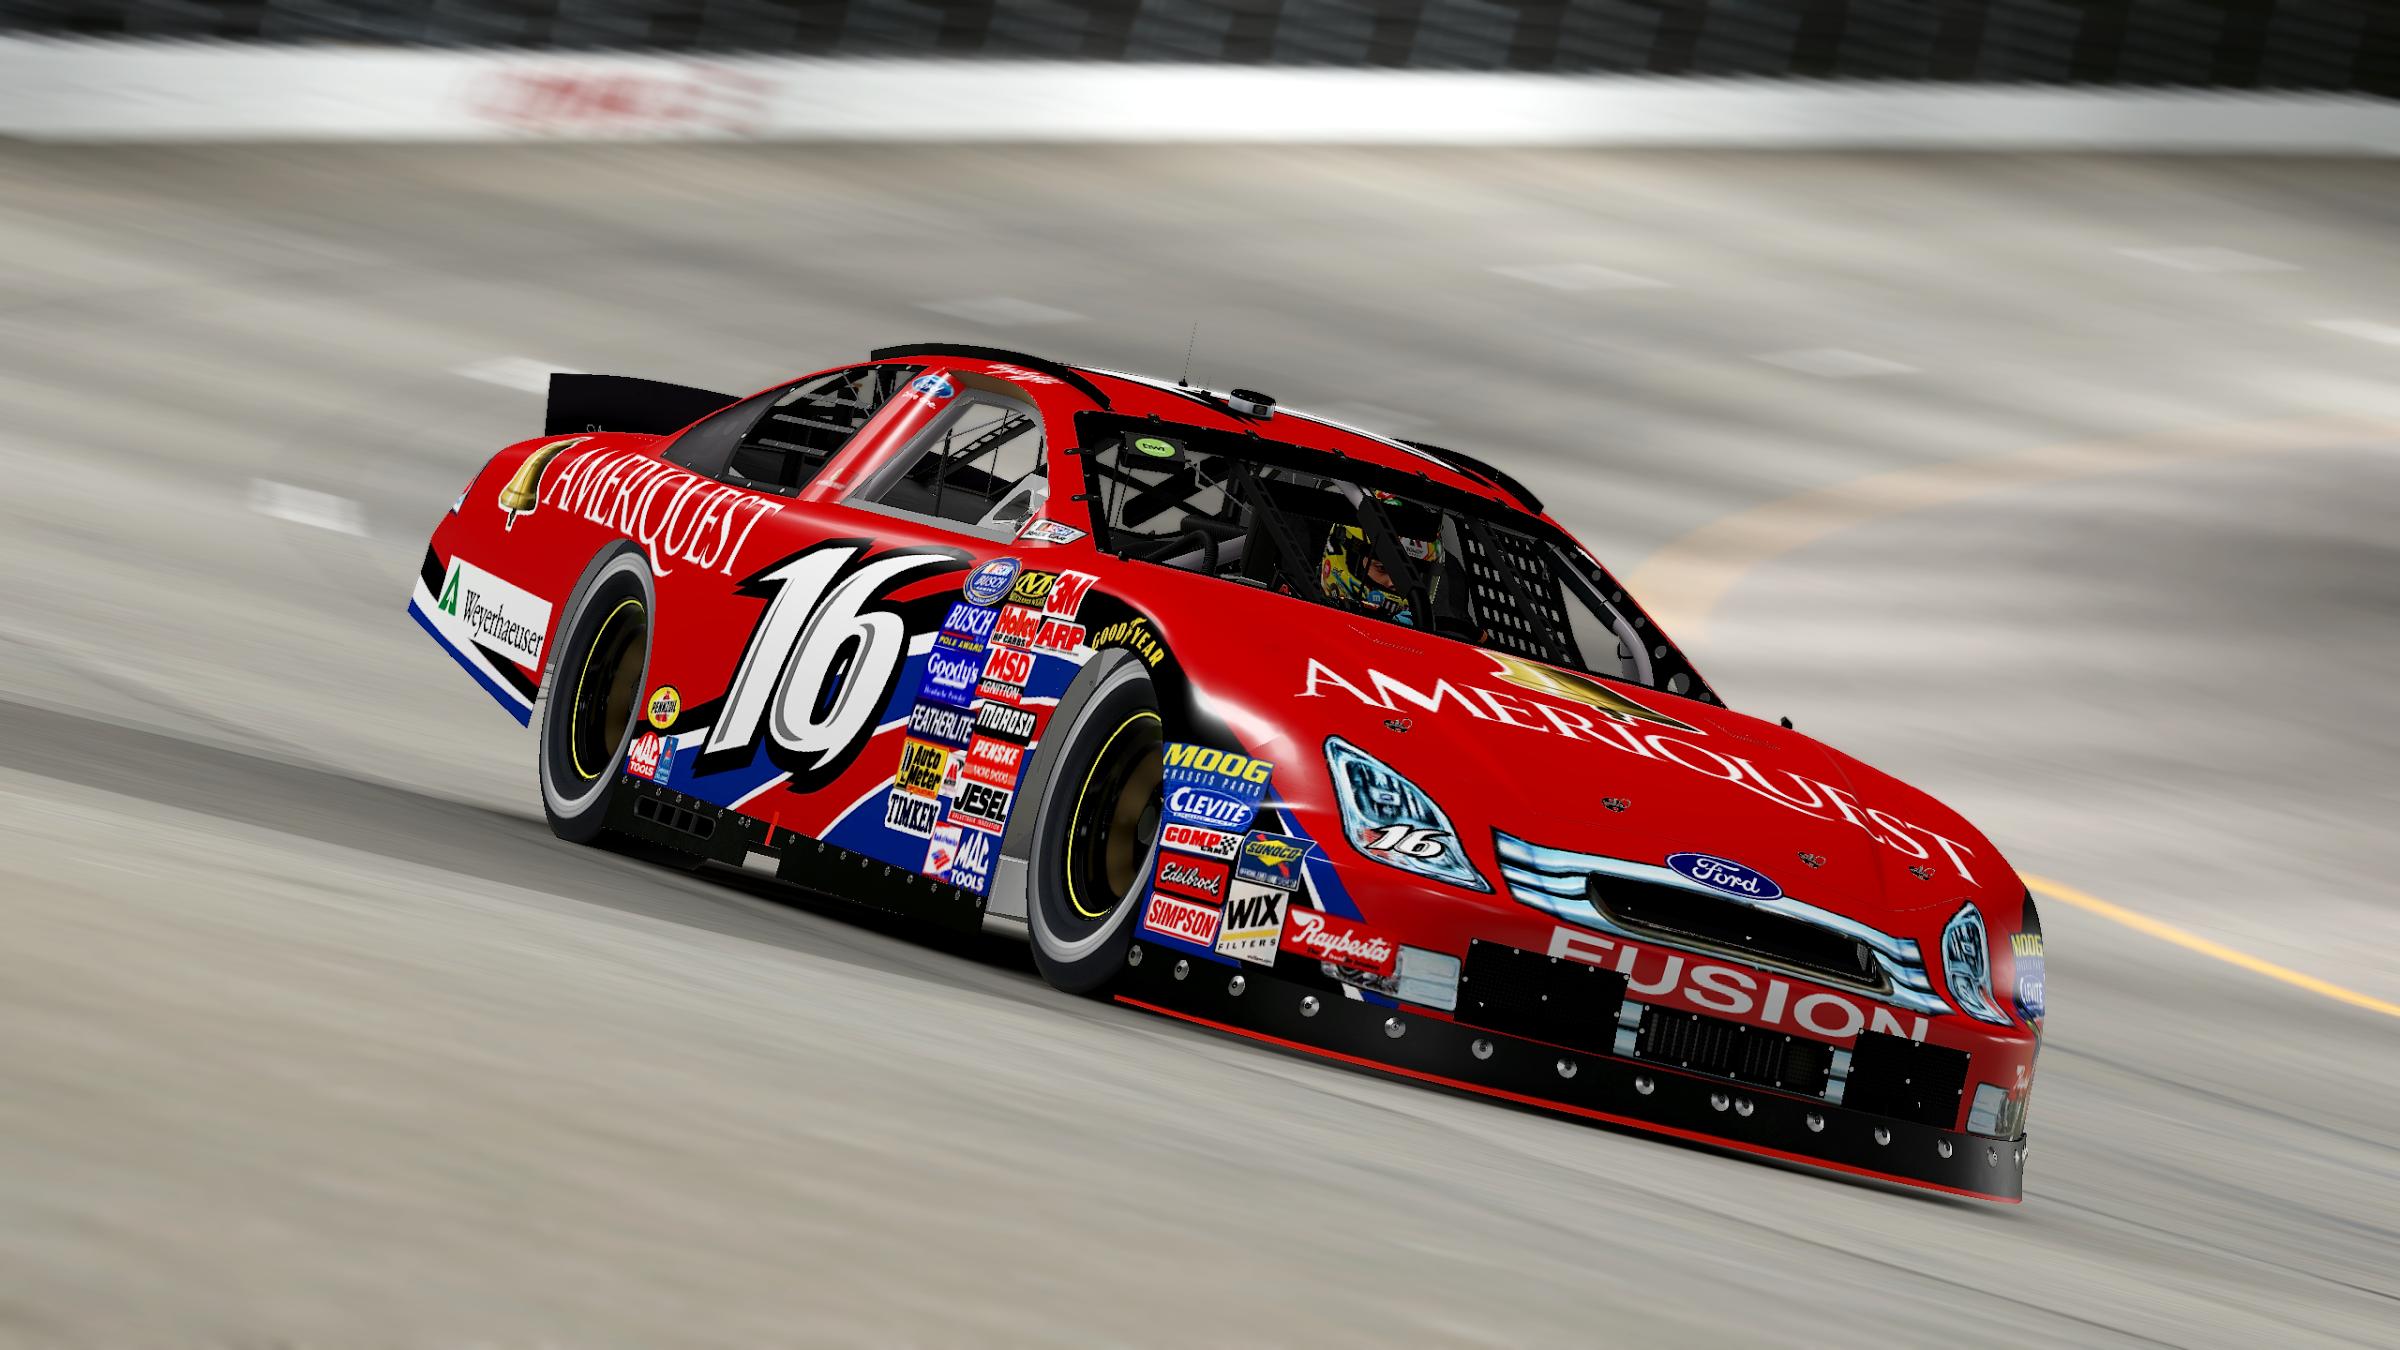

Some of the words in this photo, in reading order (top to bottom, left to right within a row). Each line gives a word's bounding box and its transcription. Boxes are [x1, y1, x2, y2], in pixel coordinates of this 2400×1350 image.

[542, 446, 784, 577] AMERIQUEST
[974, 574, 1007, 588] BUSCH
[1047, 574, 1093, 616] 3M
[463, 589, 543, 658] Weyerhaeuser
[945, 604, 997, 636] BUSCH
[996, 606, 1040, 648] Holley
[1035, 621, 1085, 651] ARP
[702, 544, 958, 772] 16
[939, 635, 957, 647] POLE
[958, 640, 984, 652] AWARD
[1003, 635, 1025, 647] CARBS
[1091, 617, 1164, 667] GOODYEAR
[928, 653, 979, 690] Goody's
[986, 649, 1030, 683] MSD
[981, 680, 1020, 700] IGNITION
[908, 704, 975, 743] FEATHERLITE
[979, 702, 1035, 737] MOROSO
[632, 735, 658, 766] MAC
[913, 746, 941, 769] Auto
[972, 739, 1020, 766] PENSKE
[1163, 743, 1273, 783] MOOG
[630, 761, 655, 776] TOOLS
[907, 768, 942, 790] Meter
[1163, 769, 1214, 786] CHASSIS
[1222, 778, 1260, 797] PARTS
[1294, 657, 1983, 888] AMERIQUEST
[887, 793, 938, 834] TIMKEN
[954, 783, 1008, 822] JESEL
[1171, 786, 1250, 823] CLEVITE
[954, 831, 989, 875] MAC
[1165, 827, 1222, 848] COMP
[1249, 843, 1298, 858] SUNOCO
[1364, 824, 1452, 858] 16
[951, 869, 984, 892] TOOLS
[1160, 861, 1221, 895] Edelbrock
[1692, 858, 1760, 893] Ford
[1149, 899, 1216, 938] SIMPSON
[1227, 894, 1282, 930] WIX
[1218, 939, 1276, 951] FILTERS
[1291, 909, 1392, 963] Raybestos
[2011, 934, 2043, 957] MOOG
[1546, 925, 1929, 1043] FUSION
